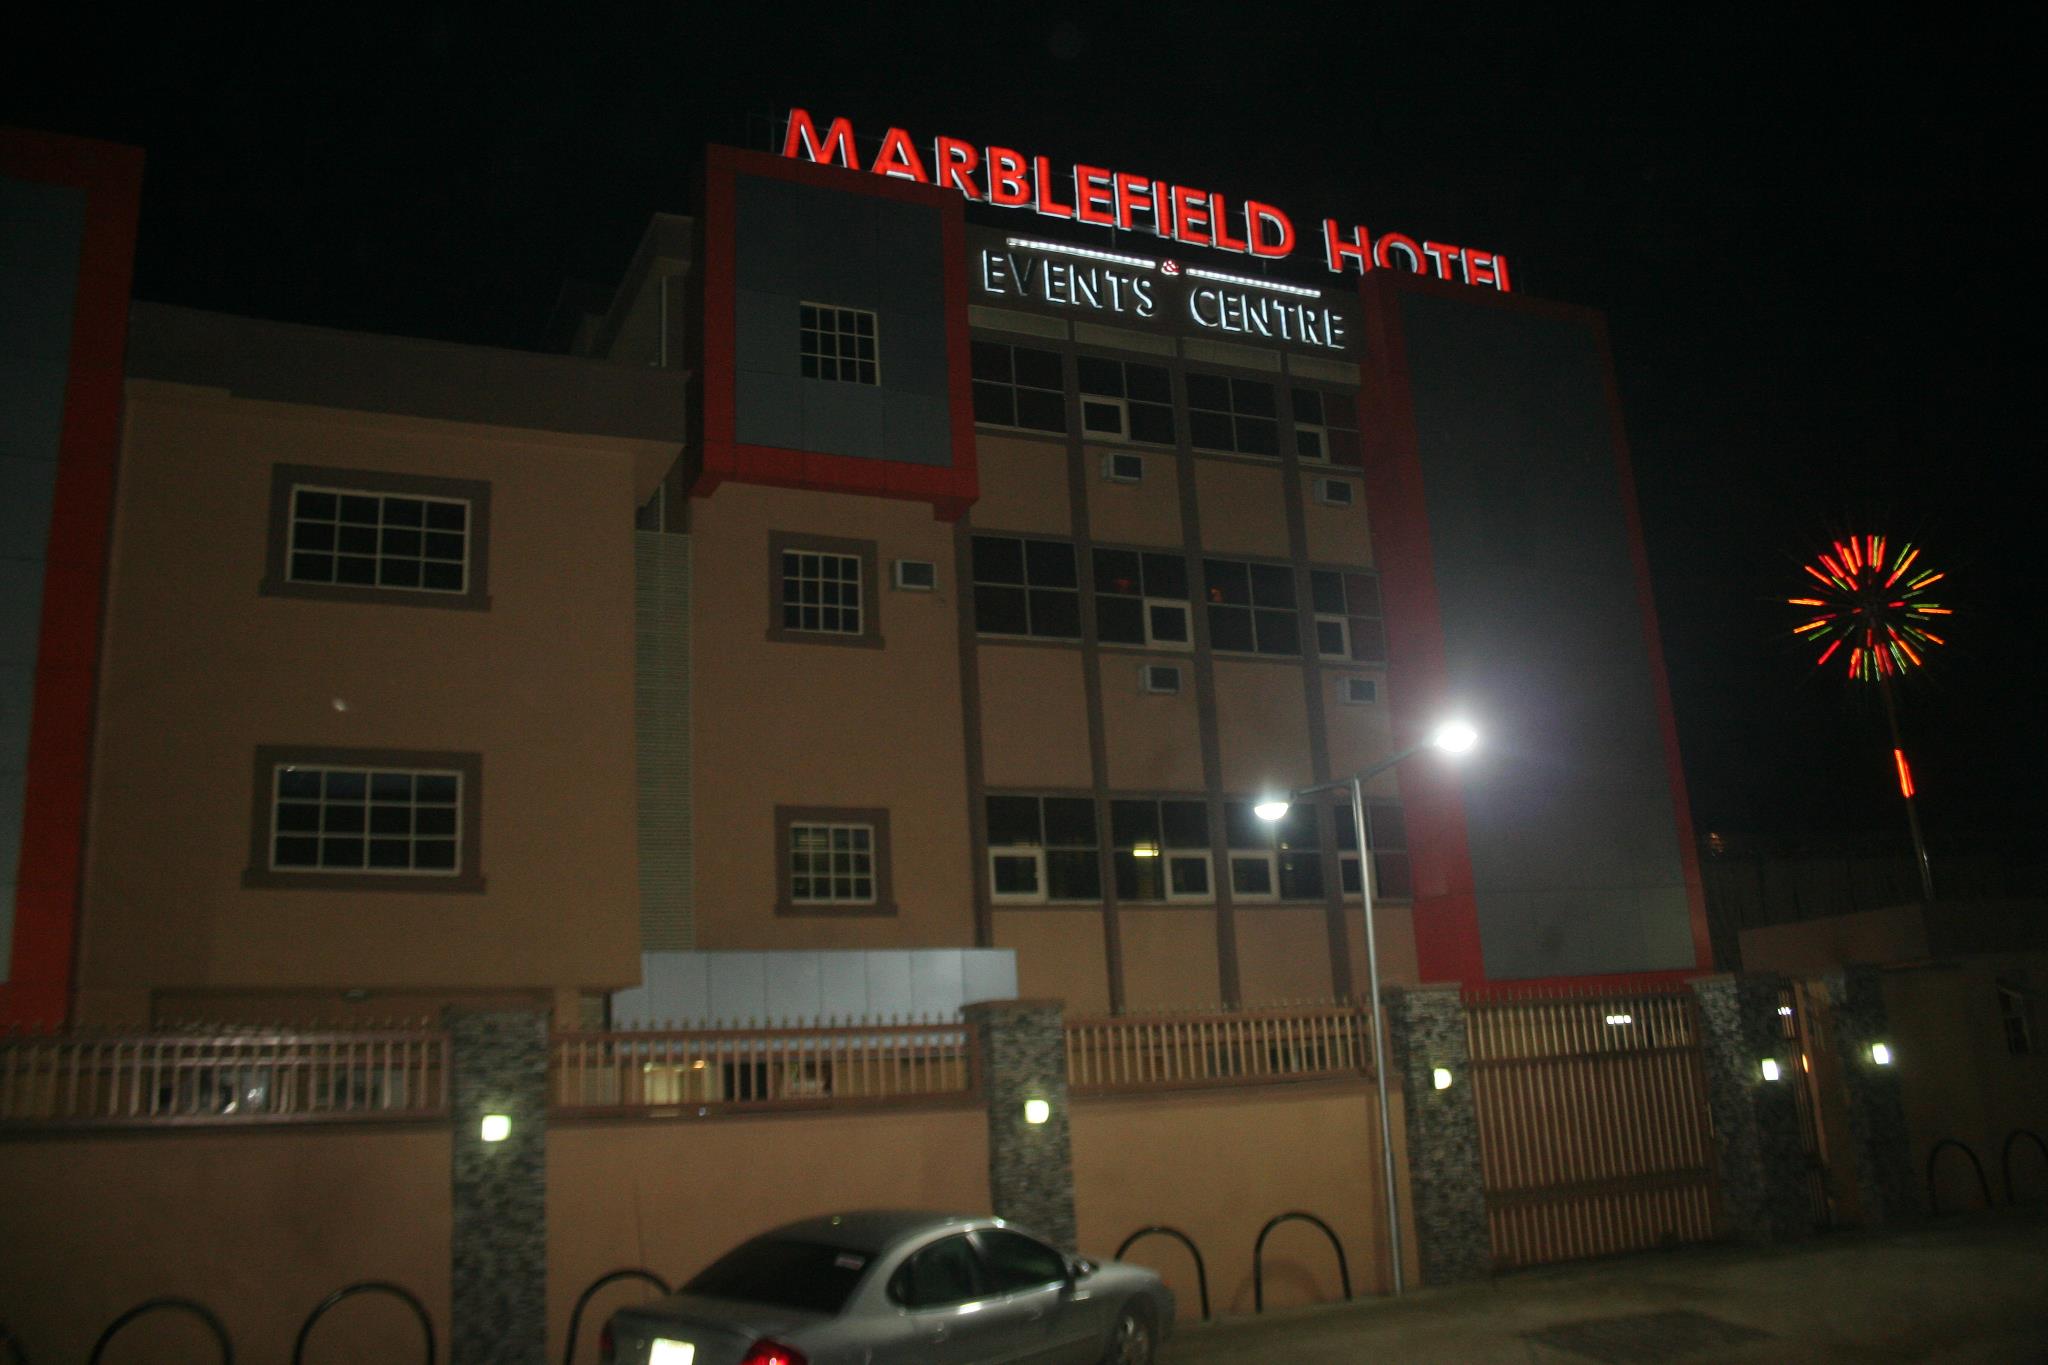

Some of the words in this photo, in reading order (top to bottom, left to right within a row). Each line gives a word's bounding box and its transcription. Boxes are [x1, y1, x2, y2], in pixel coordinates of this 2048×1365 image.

[782, 107, 1296, 260] MARBLEFIELD
[981, 248, 1157, 318] EVENTS
[1189, 286, 1346, 350] CENTRE
[1160, 257, 1181, 277] &
